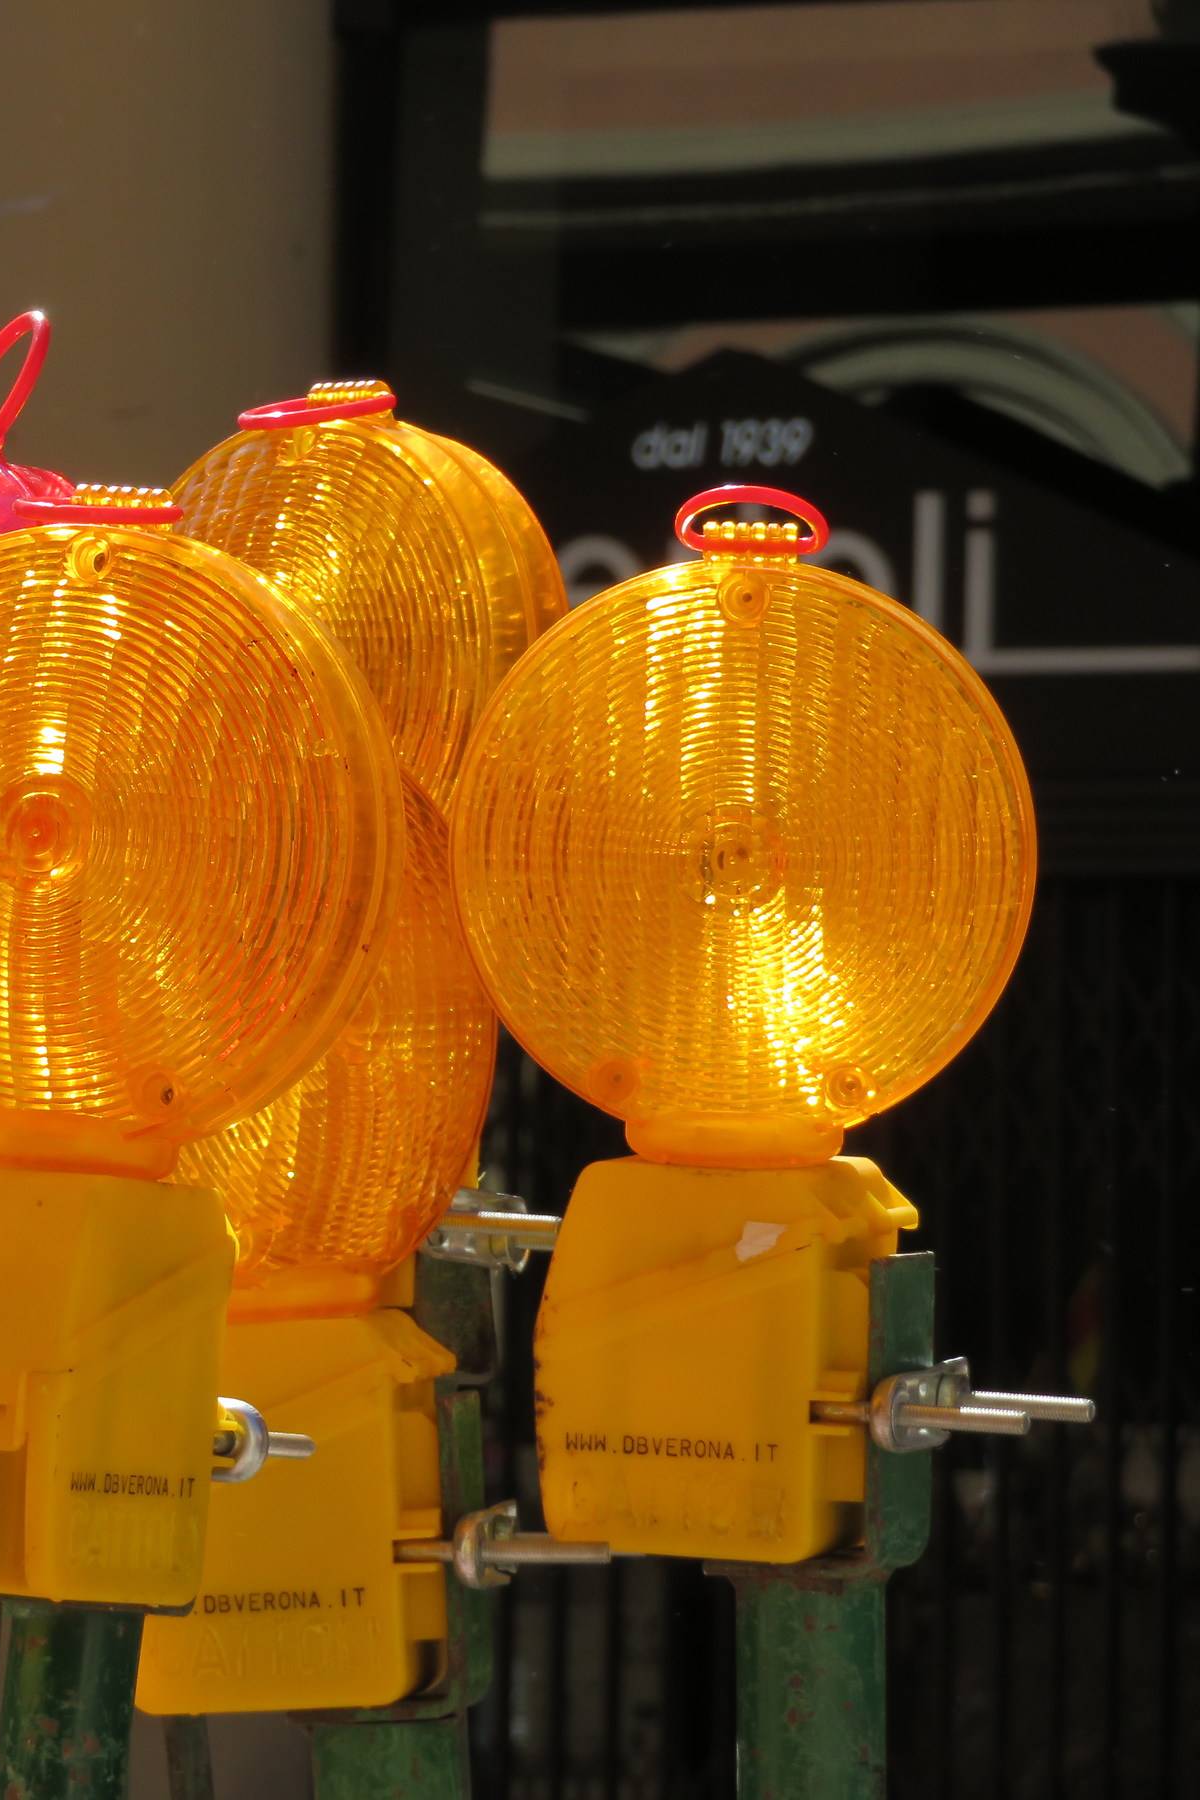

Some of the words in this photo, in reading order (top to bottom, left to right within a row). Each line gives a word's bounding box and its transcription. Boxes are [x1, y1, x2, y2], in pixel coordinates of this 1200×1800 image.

[631, 422, 709, 471] dal
[720, 417, 814, 467] 1939
[564, 1431, 779, 1463] WWW.DBVERONA.IT
[70, 1471, 196, 1499] WWW.DBVERONA.IT
